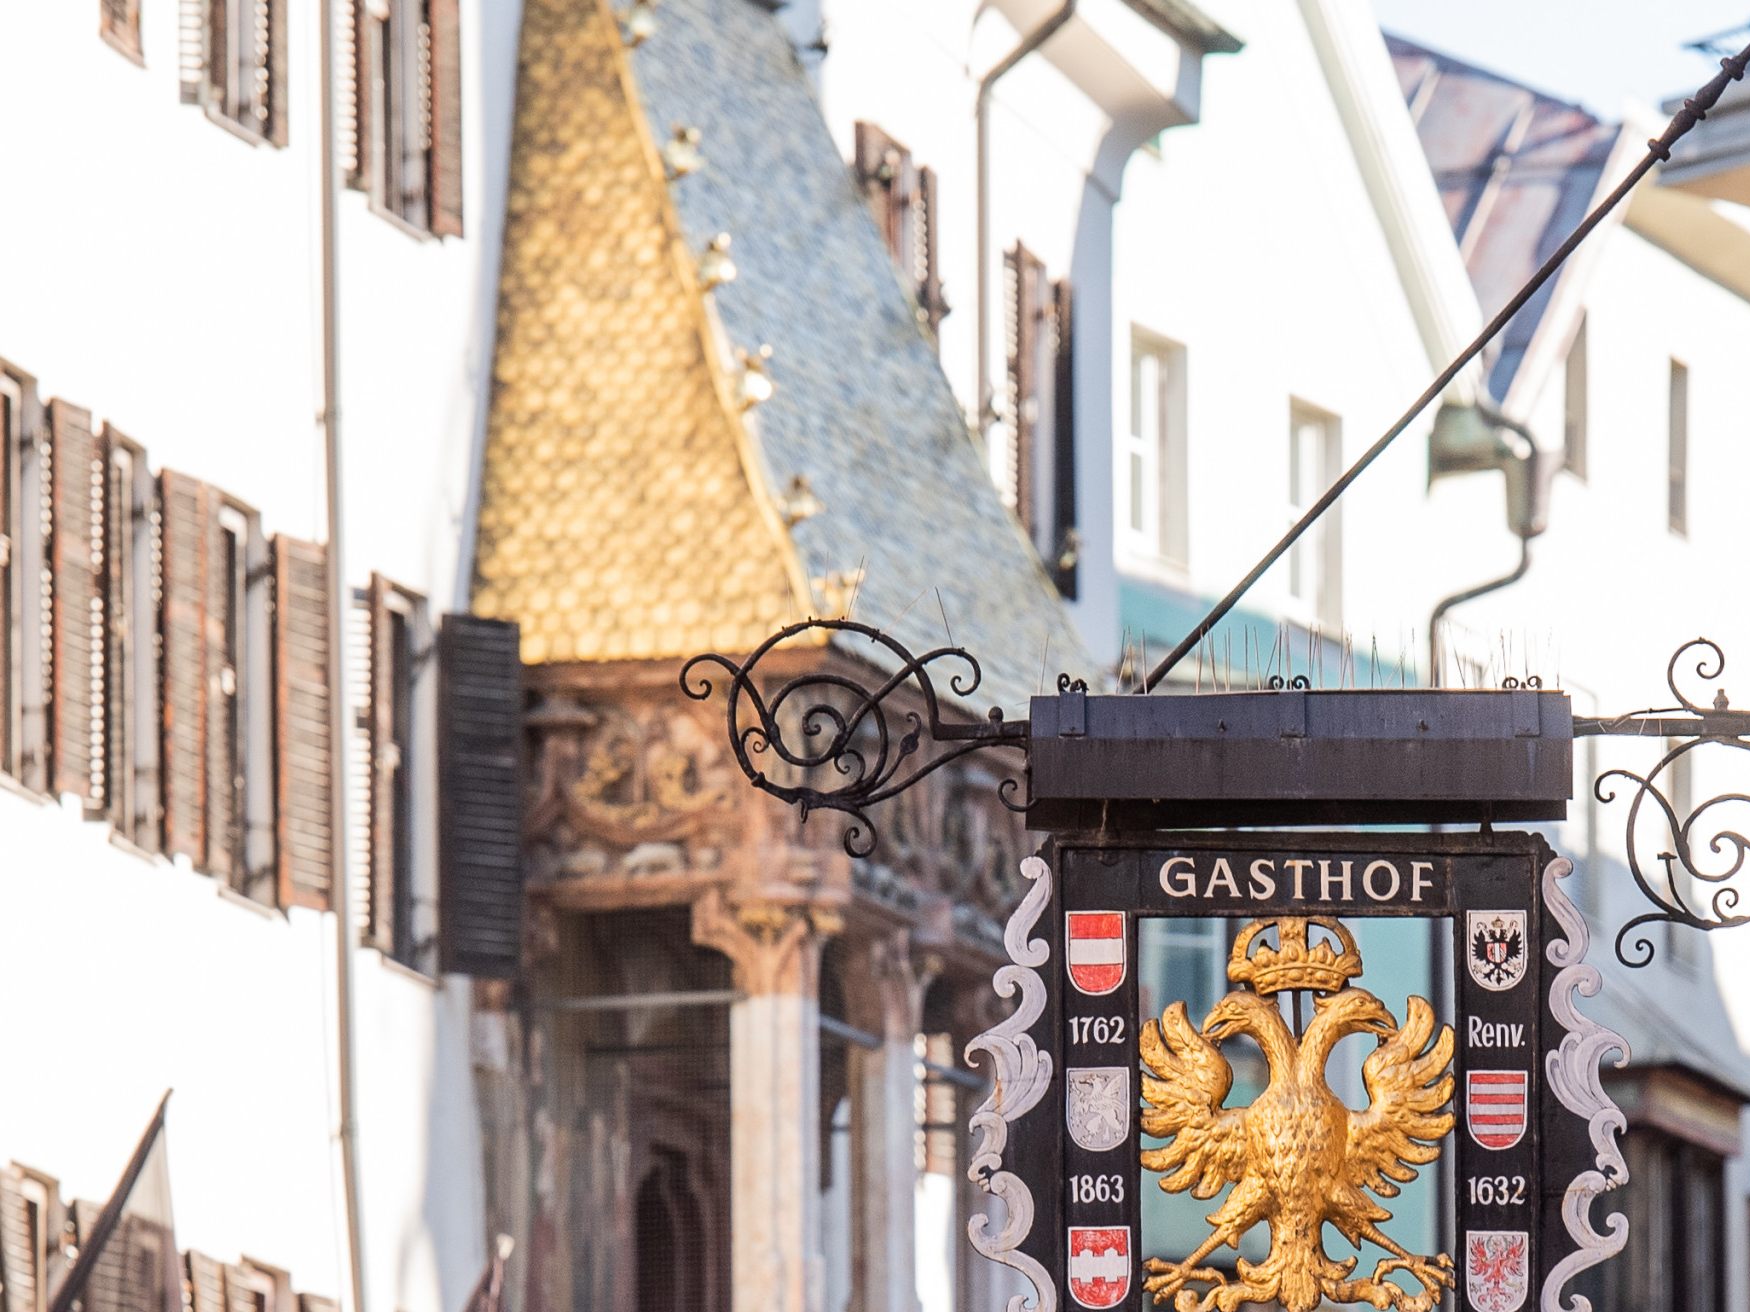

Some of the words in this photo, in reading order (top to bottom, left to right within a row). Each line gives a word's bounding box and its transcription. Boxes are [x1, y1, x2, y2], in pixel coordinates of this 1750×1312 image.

[1158, 856, 1434, 902] GASTHOF
[1068, 1015, 1127, 1046] 1762
[1467, 1015, 1527, 1048] Renv.
[1068, 1174, 1125, 1204] 1863
[1467, 1175, 1526, 1206] 1632
